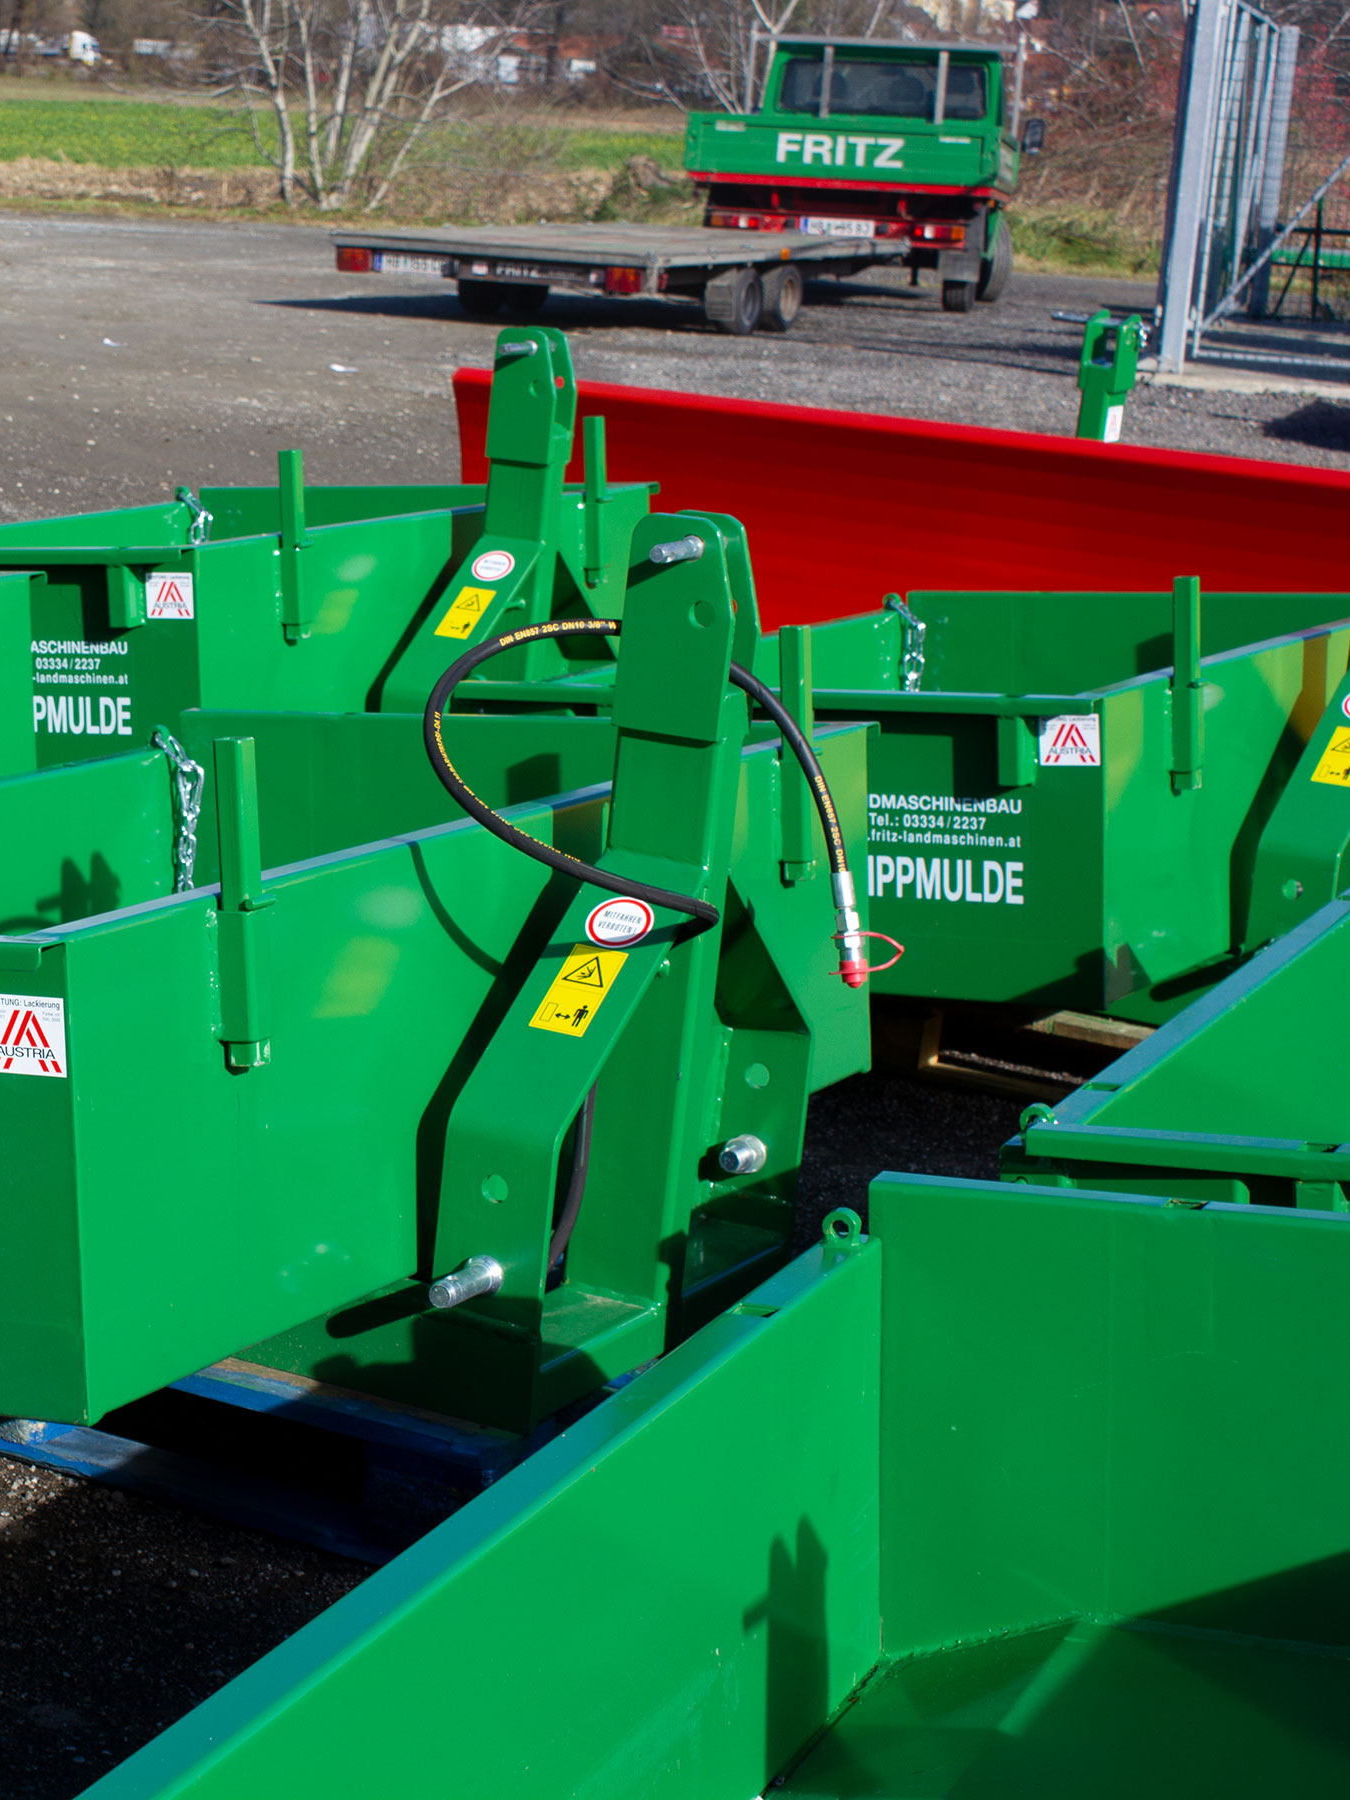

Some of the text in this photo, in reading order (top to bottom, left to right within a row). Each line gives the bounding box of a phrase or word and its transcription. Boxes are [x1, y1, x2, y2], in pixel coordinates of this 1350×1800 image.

[776, 132, 905, 168] FRITZ
[500, 634, 514, 647] DIN
[514, 627, 540, 642] EN857
[541, 623, 560, 634] 2SC
[562, 621, 586, 631] DN10
[31, 640, 128, 655] ASCHINENBAU
[35, 657, 101, 670] 03334/2237
[32, 672, 129, 685] -landmaschinen.at
[32, 695, 133, 735] PMULDE
[1048, 747, 1092, 755] AUSTRIA
[814, 775, 827, 793] DIN
[821, 794, 838, 824] EN857
[830, 825, 842, 846] 2SC
[868, 794, 1022, 814] DMASCHINENBAU
[868, 812, 987, 830] Tel.: 03334/2237
[867, 829, 1021, 848] .fritz-landmaschinen.at
[867, 855, 1024, 905] IPPMULDE
[603, 910, 643, 925] MITFAHREN
[23, 1000, 60, 1011] Lackierung
